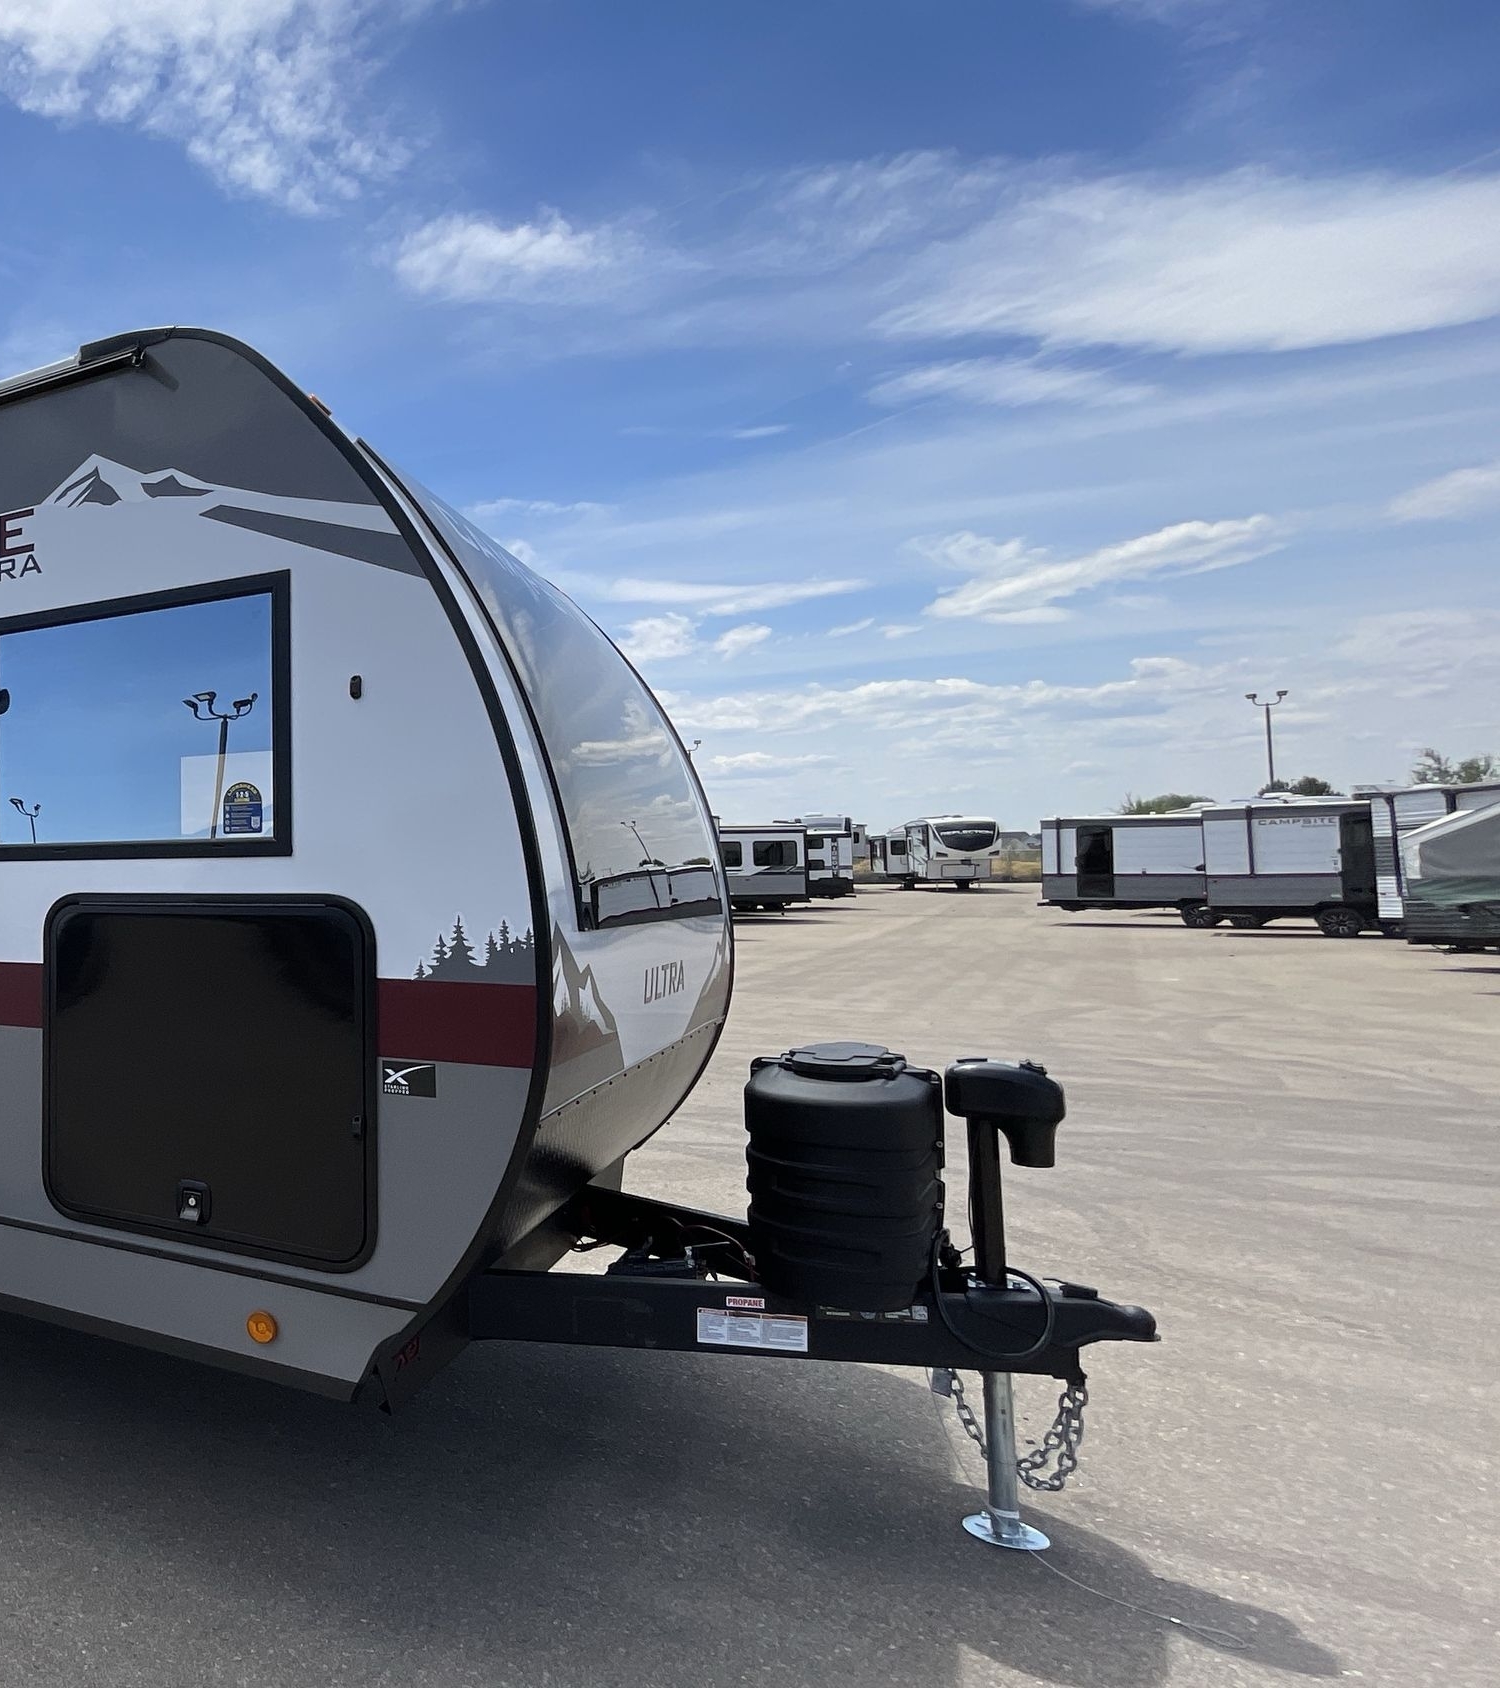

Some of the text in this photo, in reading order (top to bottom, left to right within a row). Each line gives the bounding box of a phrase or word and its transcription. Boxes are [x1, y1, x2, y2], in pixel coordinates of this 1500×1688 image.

[1258, 817, 1337, 826] CAMPSITE
[644, 960, 684, 1004] ULTRA
[728, 1298, 763, 1307] PROPANE
